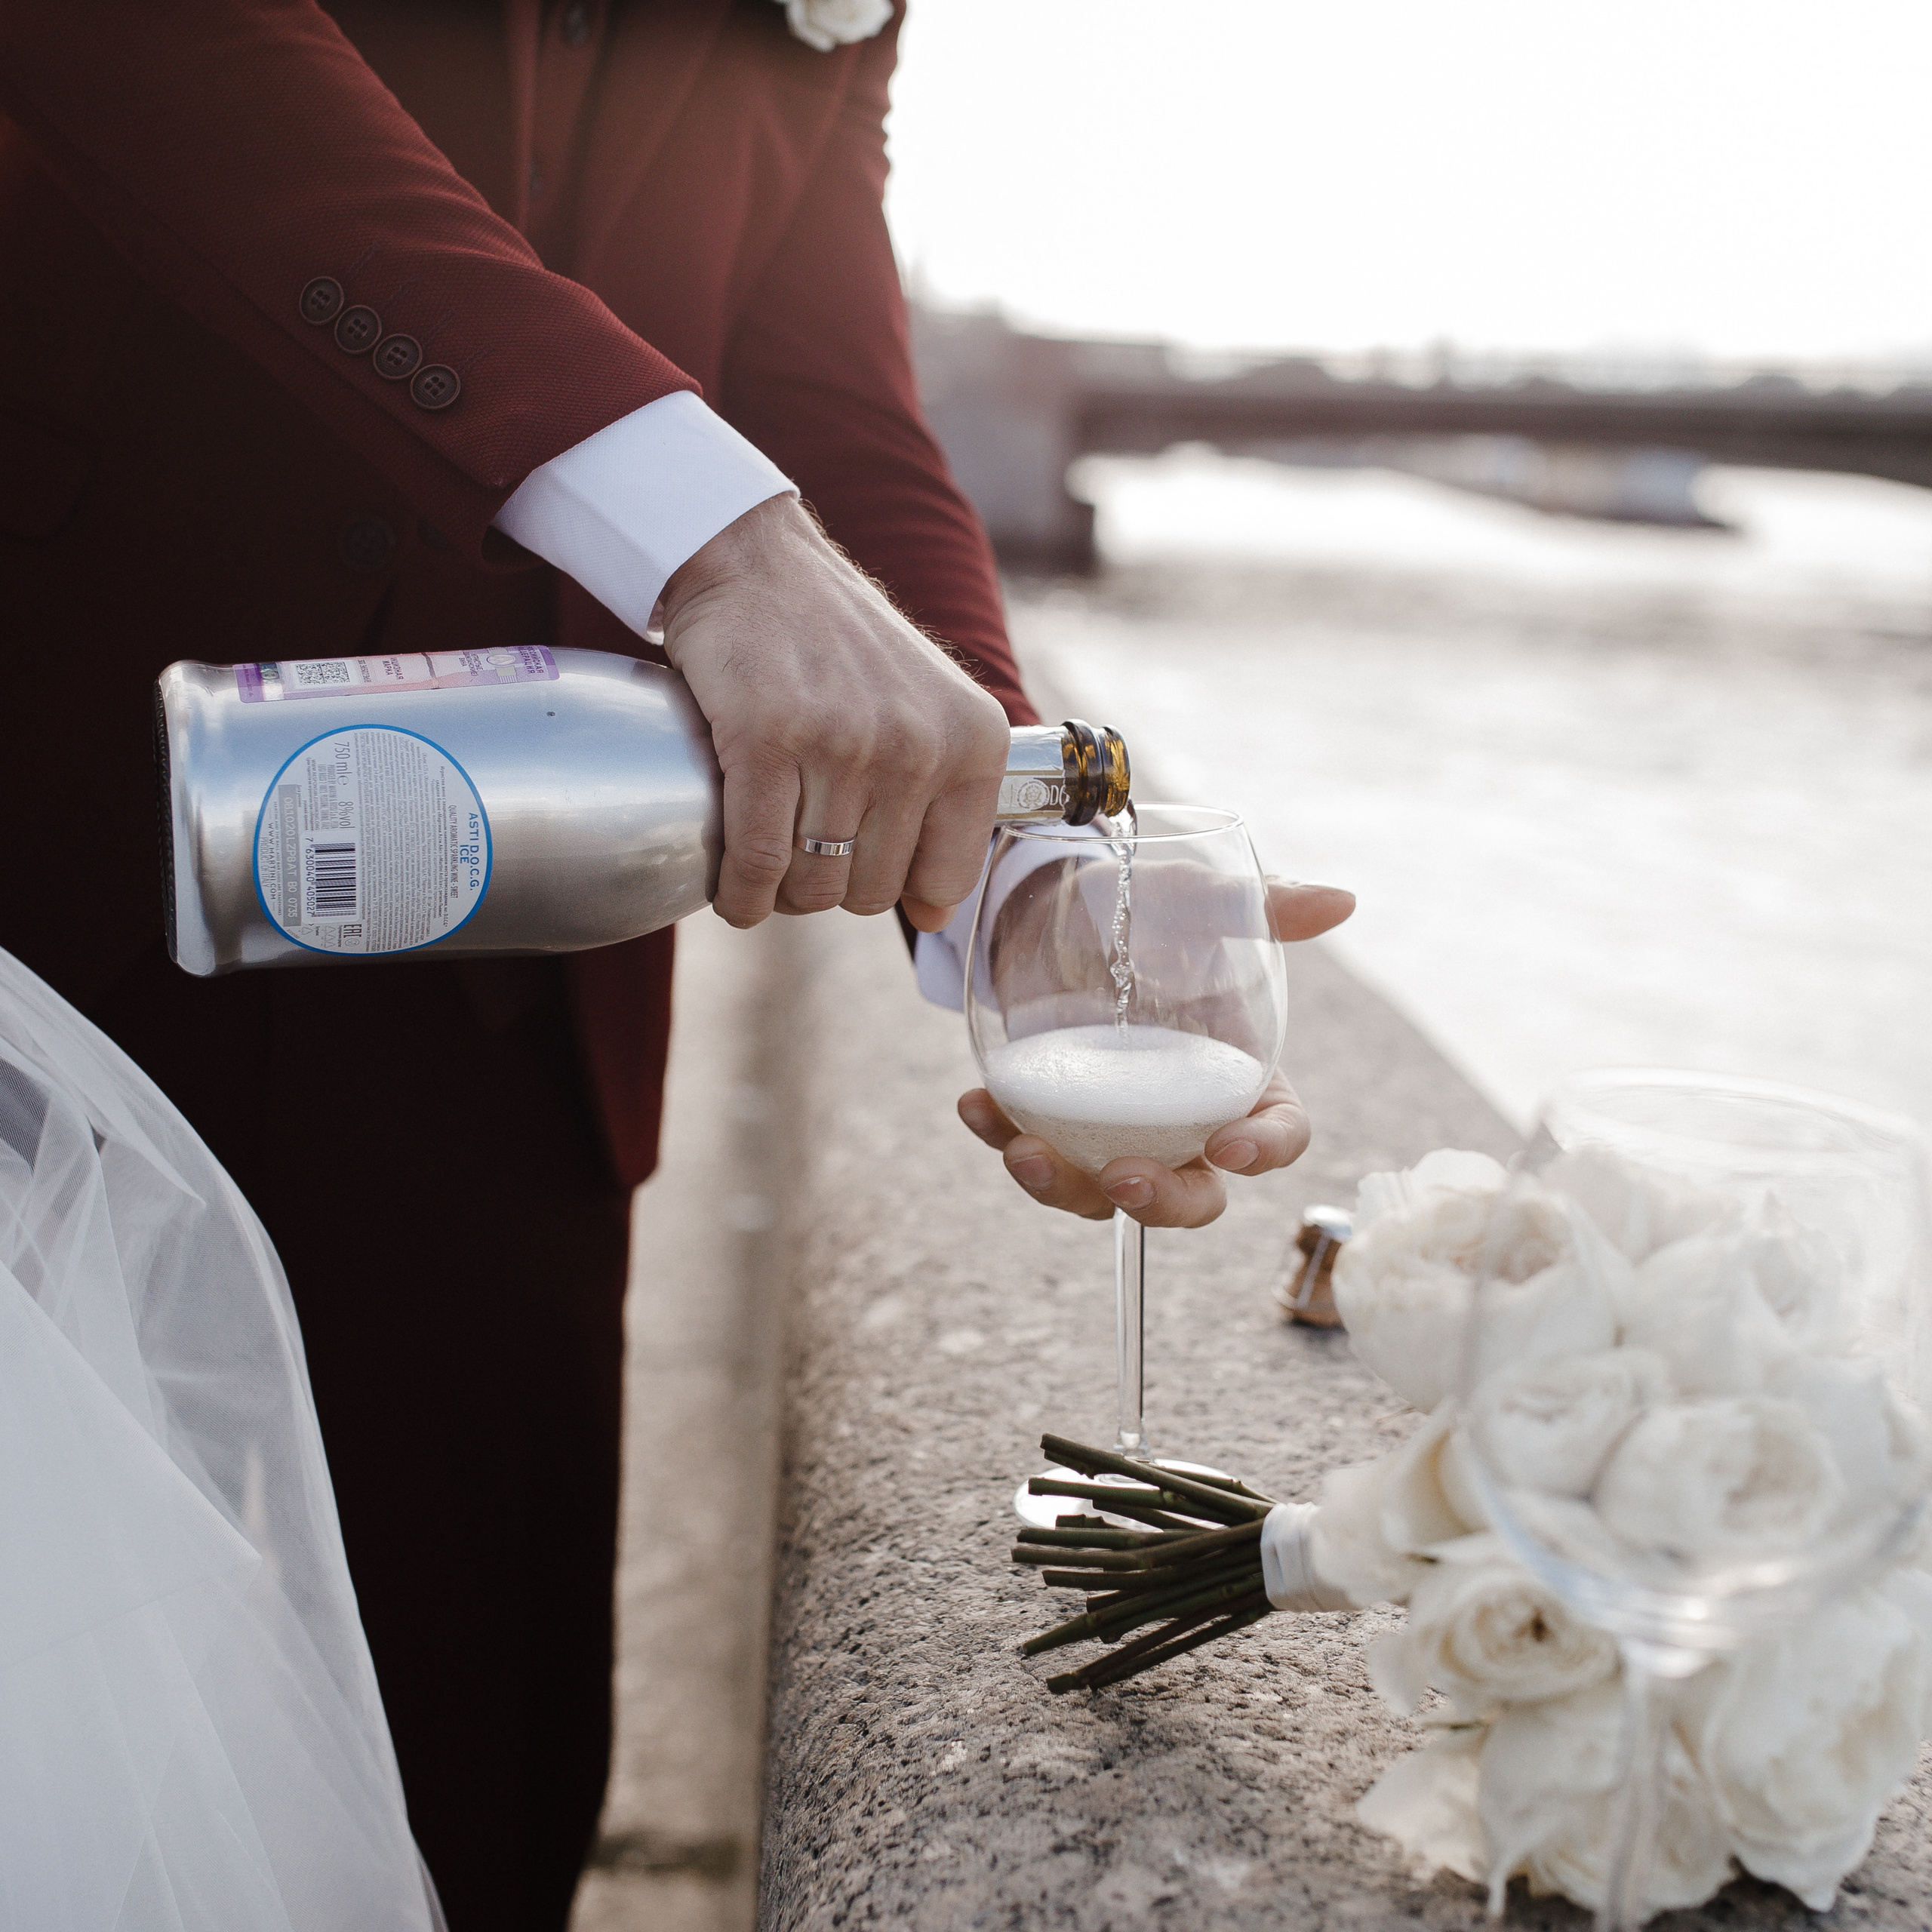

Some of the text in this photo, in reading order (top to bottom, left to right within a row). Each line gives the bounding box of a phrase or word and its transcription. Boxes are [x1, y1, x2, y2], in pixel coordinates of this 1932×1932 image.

[334, 742, 350, 759] 750
[448, 804, 457, 824] QUALITY
[460, 844, 469, 863] ICE
[469, 812, 480, 891] ASTI D.O.C.G.
[306, 848, 315, 881] 630040
[306, 886, 315, 915] 405027
